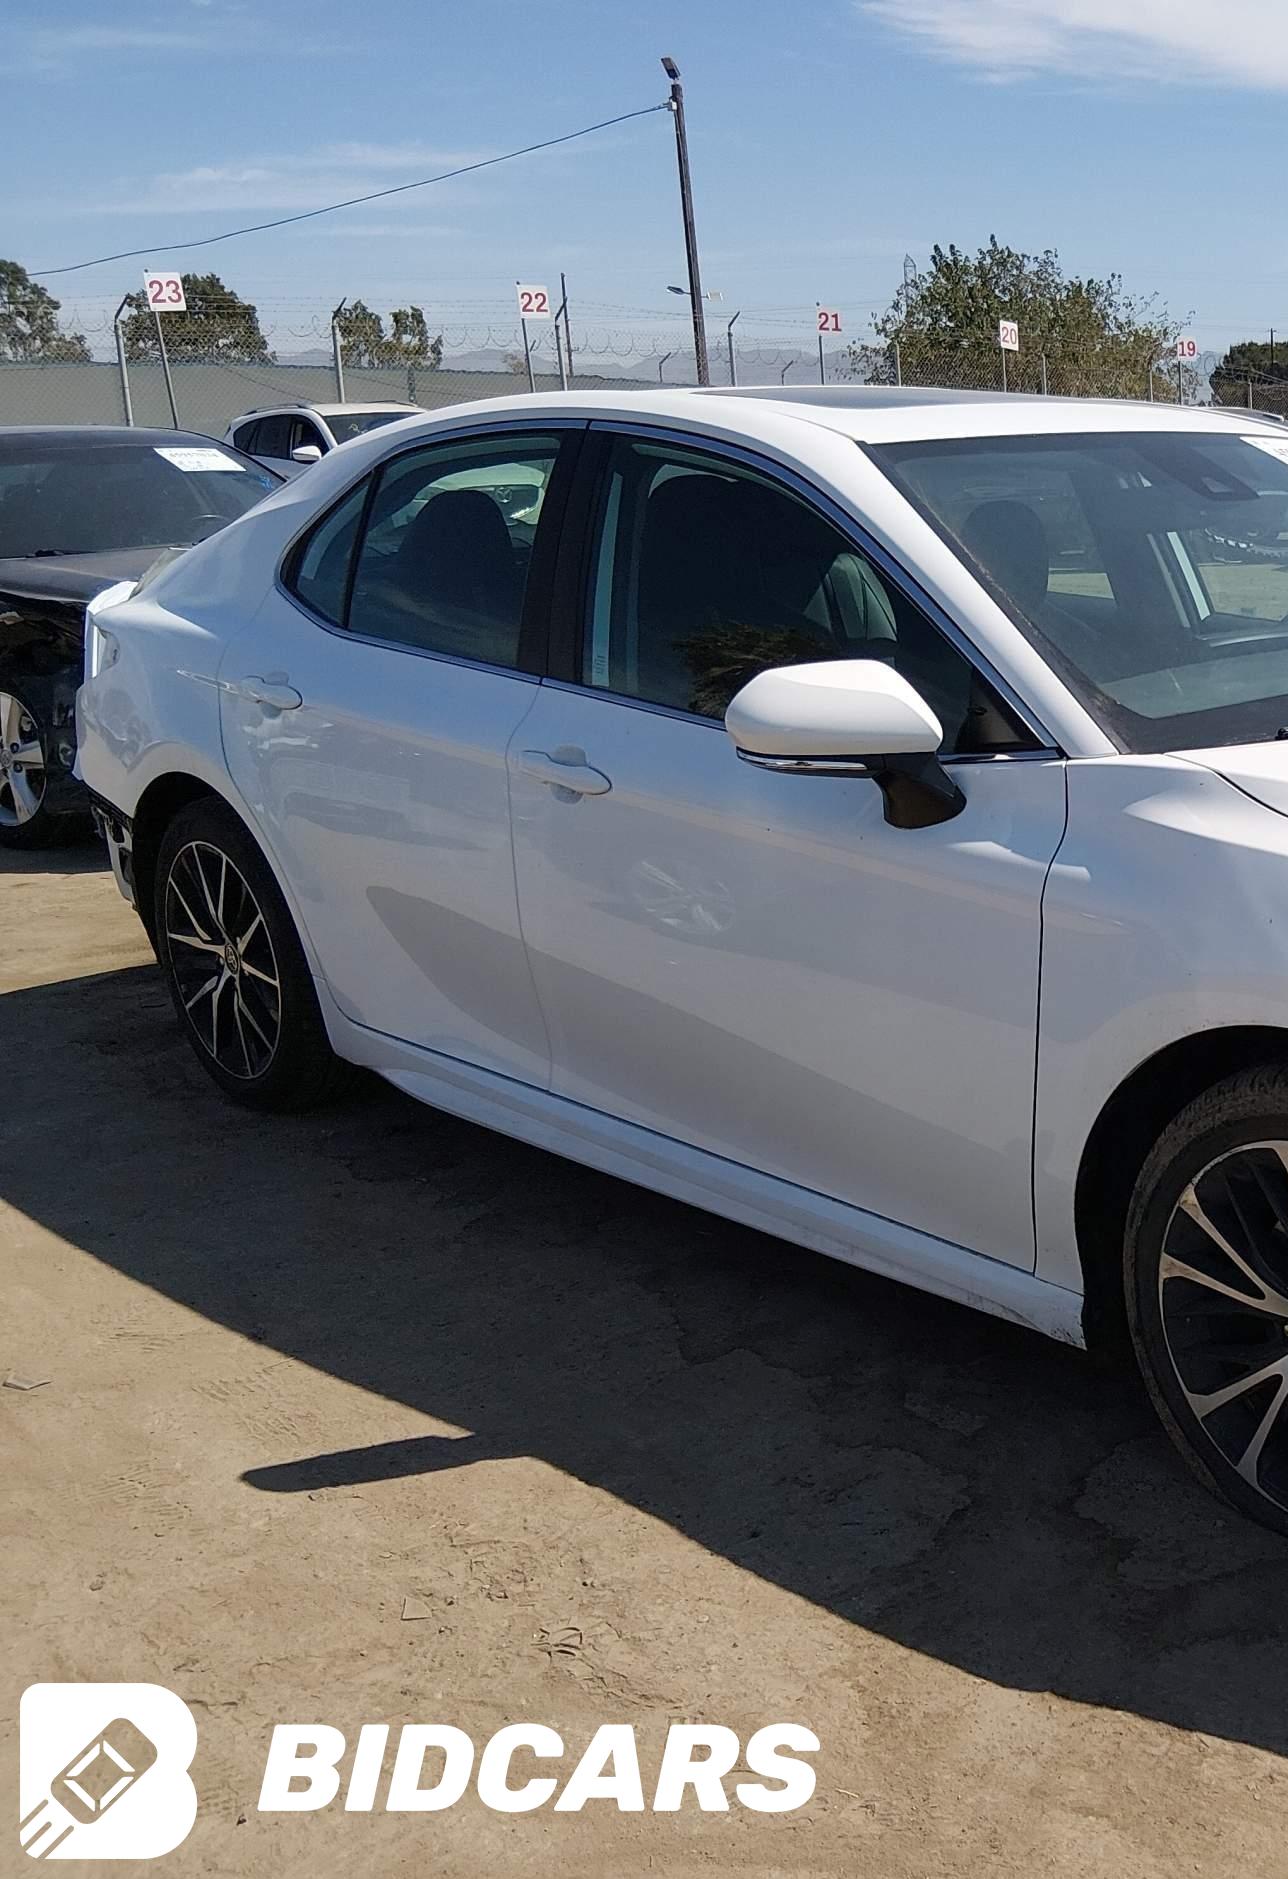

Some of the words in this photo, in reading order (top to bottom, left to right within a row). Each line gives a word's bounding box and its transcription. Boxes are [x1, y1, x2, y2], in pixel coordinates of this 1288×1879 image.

[149, 279, 182, 304] 23
[521, 292, 548, 312] 22
[818, 312, 842, 331] 21
[1002, 326, 1017, 344] 20
[1178, 340, 1196, 357] 19
